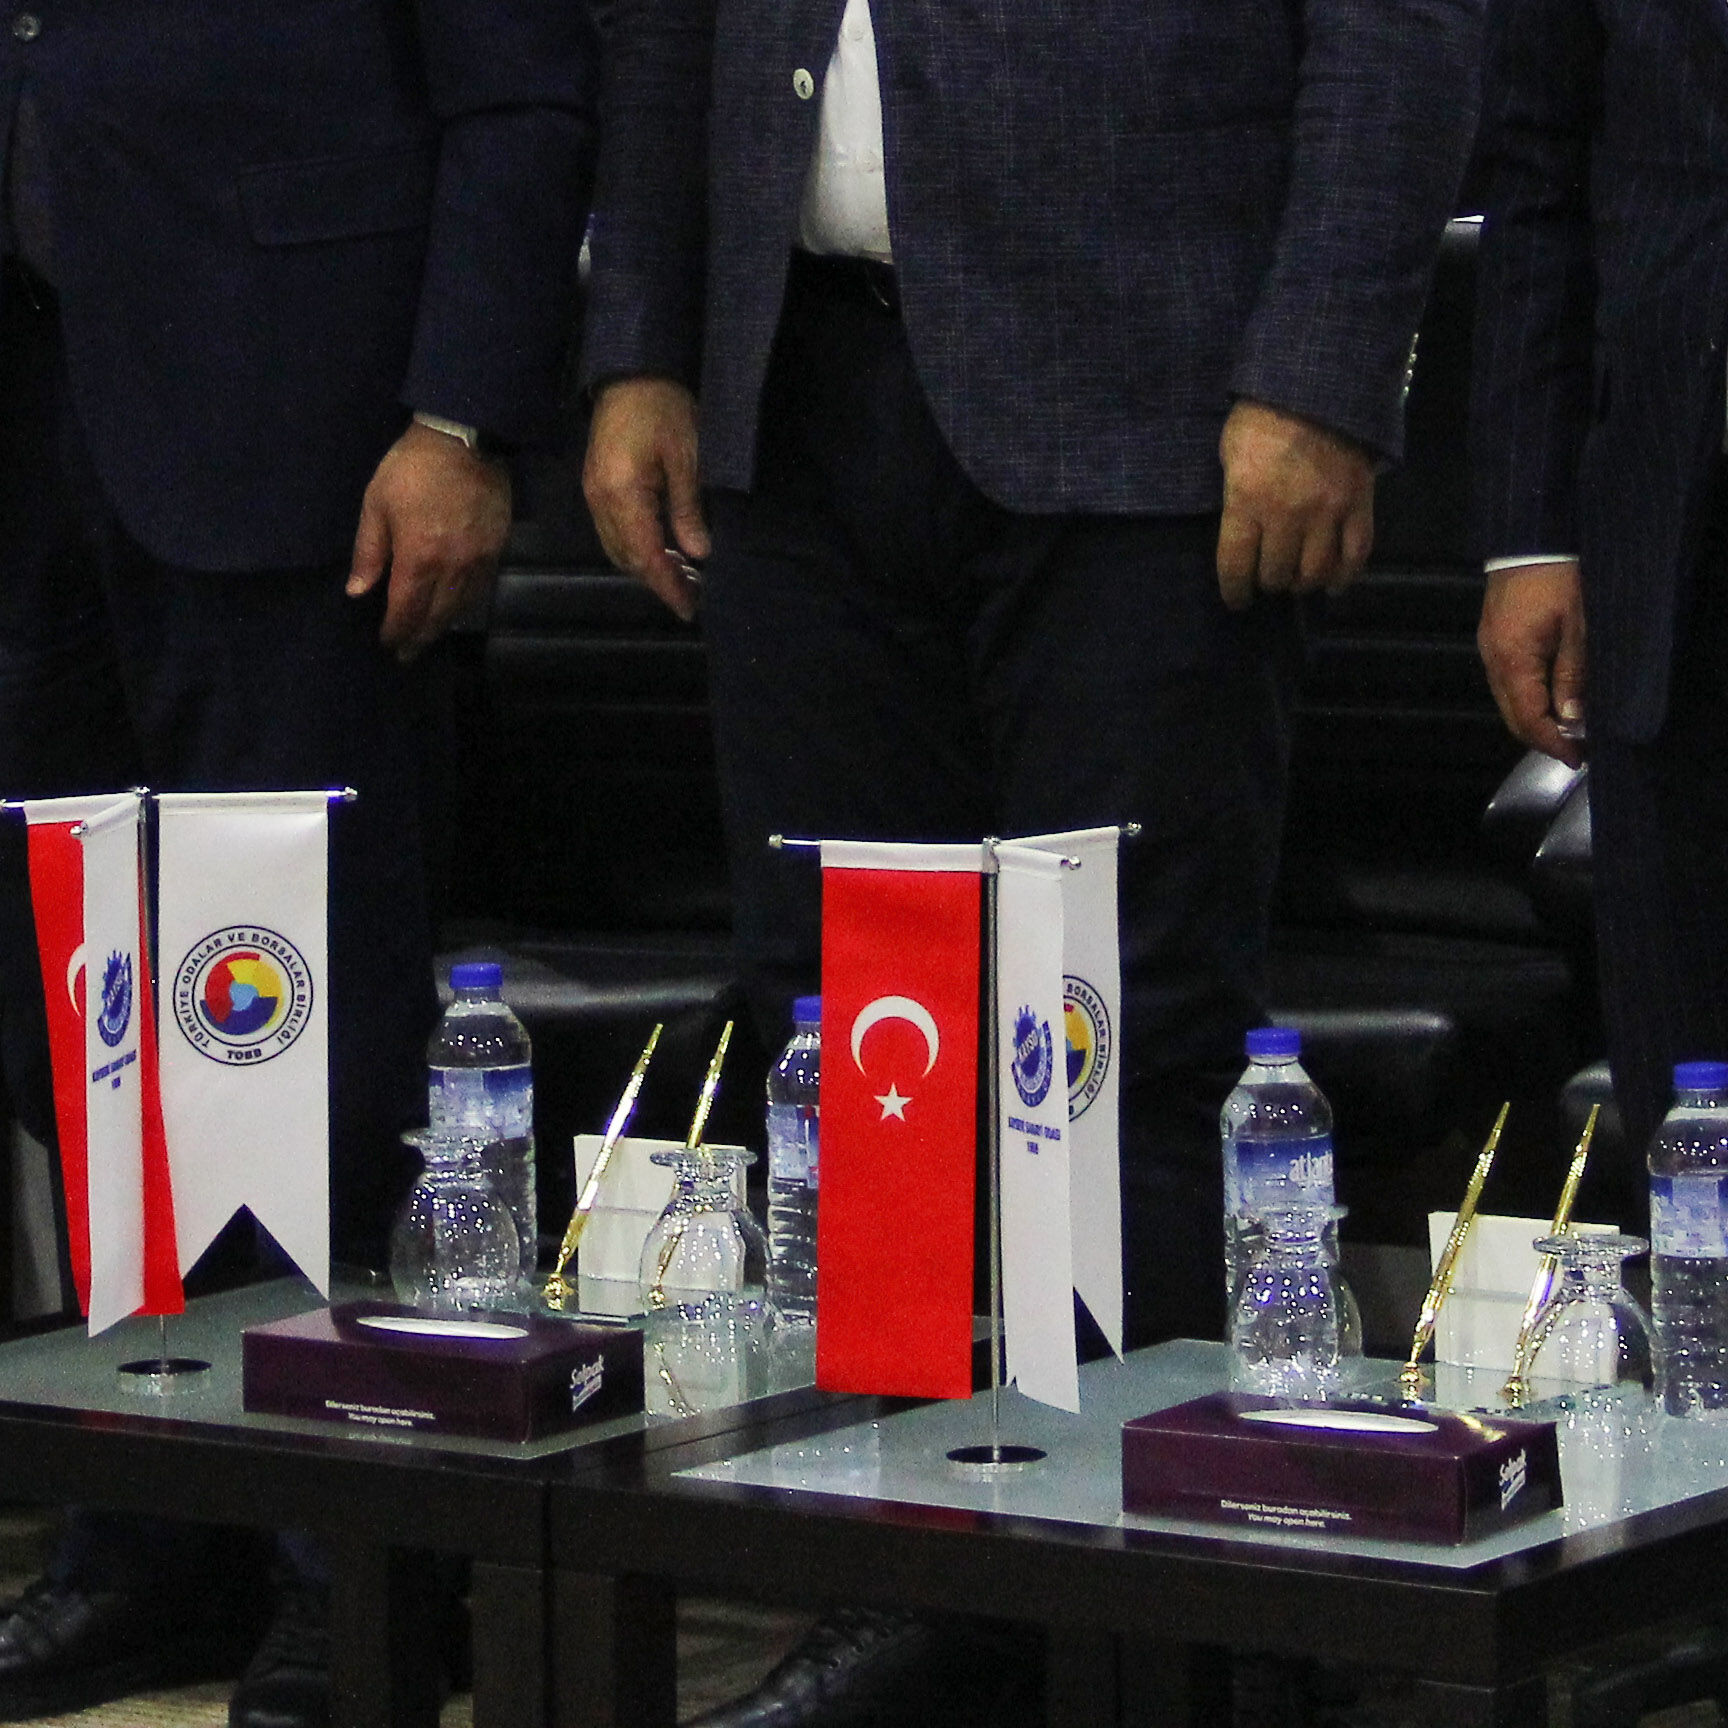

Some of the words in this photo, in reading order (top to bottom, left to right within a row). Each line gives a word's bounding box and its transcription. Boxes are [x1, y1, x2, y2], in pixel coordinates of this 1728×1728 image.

[182, 938, 222, 984] ODALAR
[227, 932, 246, 943] VE
[251, 933, 305, 988] BORSALAR
[227, 1048, 263, 1060] TOBB
